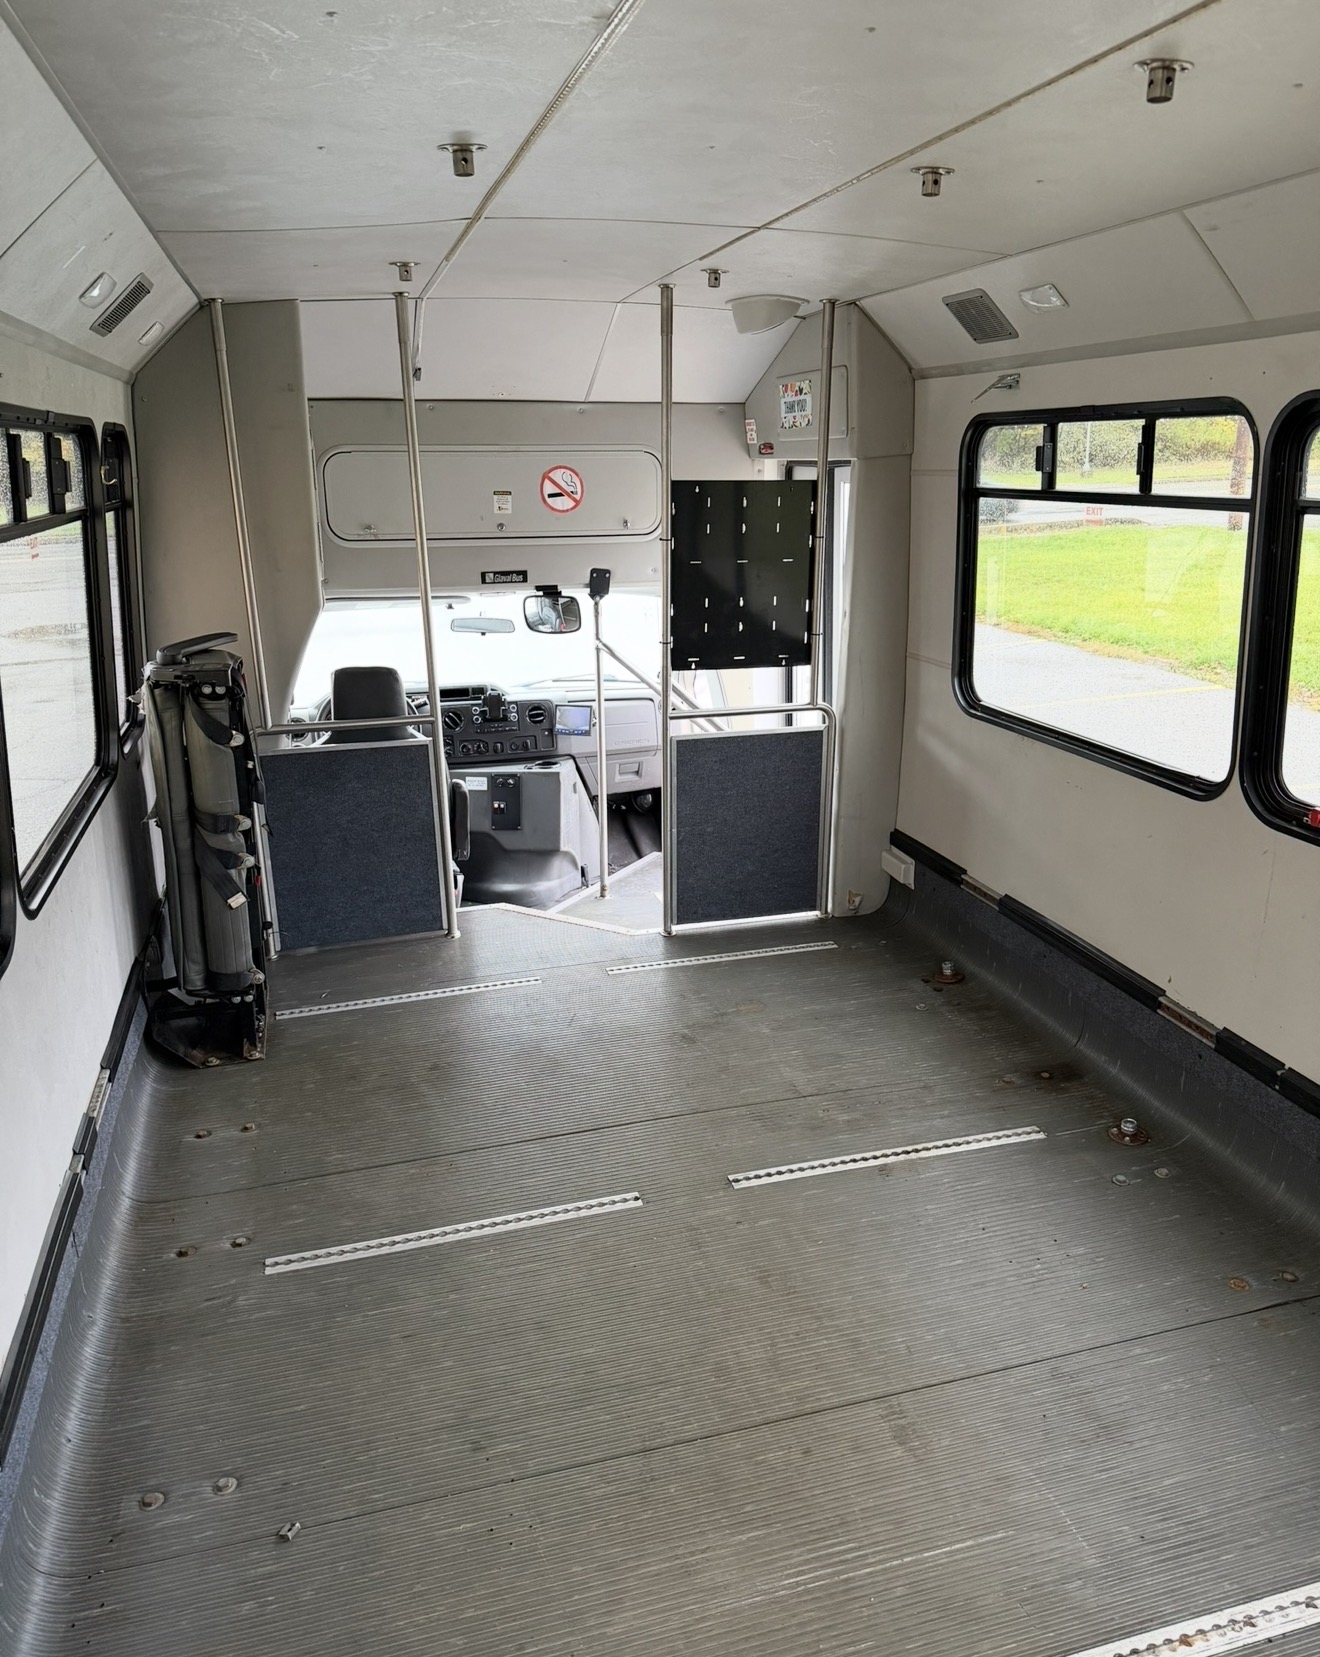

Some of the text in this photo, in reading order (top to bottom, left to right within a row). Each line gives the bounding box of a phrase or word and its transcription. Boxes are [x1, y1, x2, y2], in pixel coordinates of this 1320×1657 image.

[784, 400, 796, 414] THANK
[1086, 506, 1104, 516] EXIT
[494, 573, 523, 583] Glaval Bus
